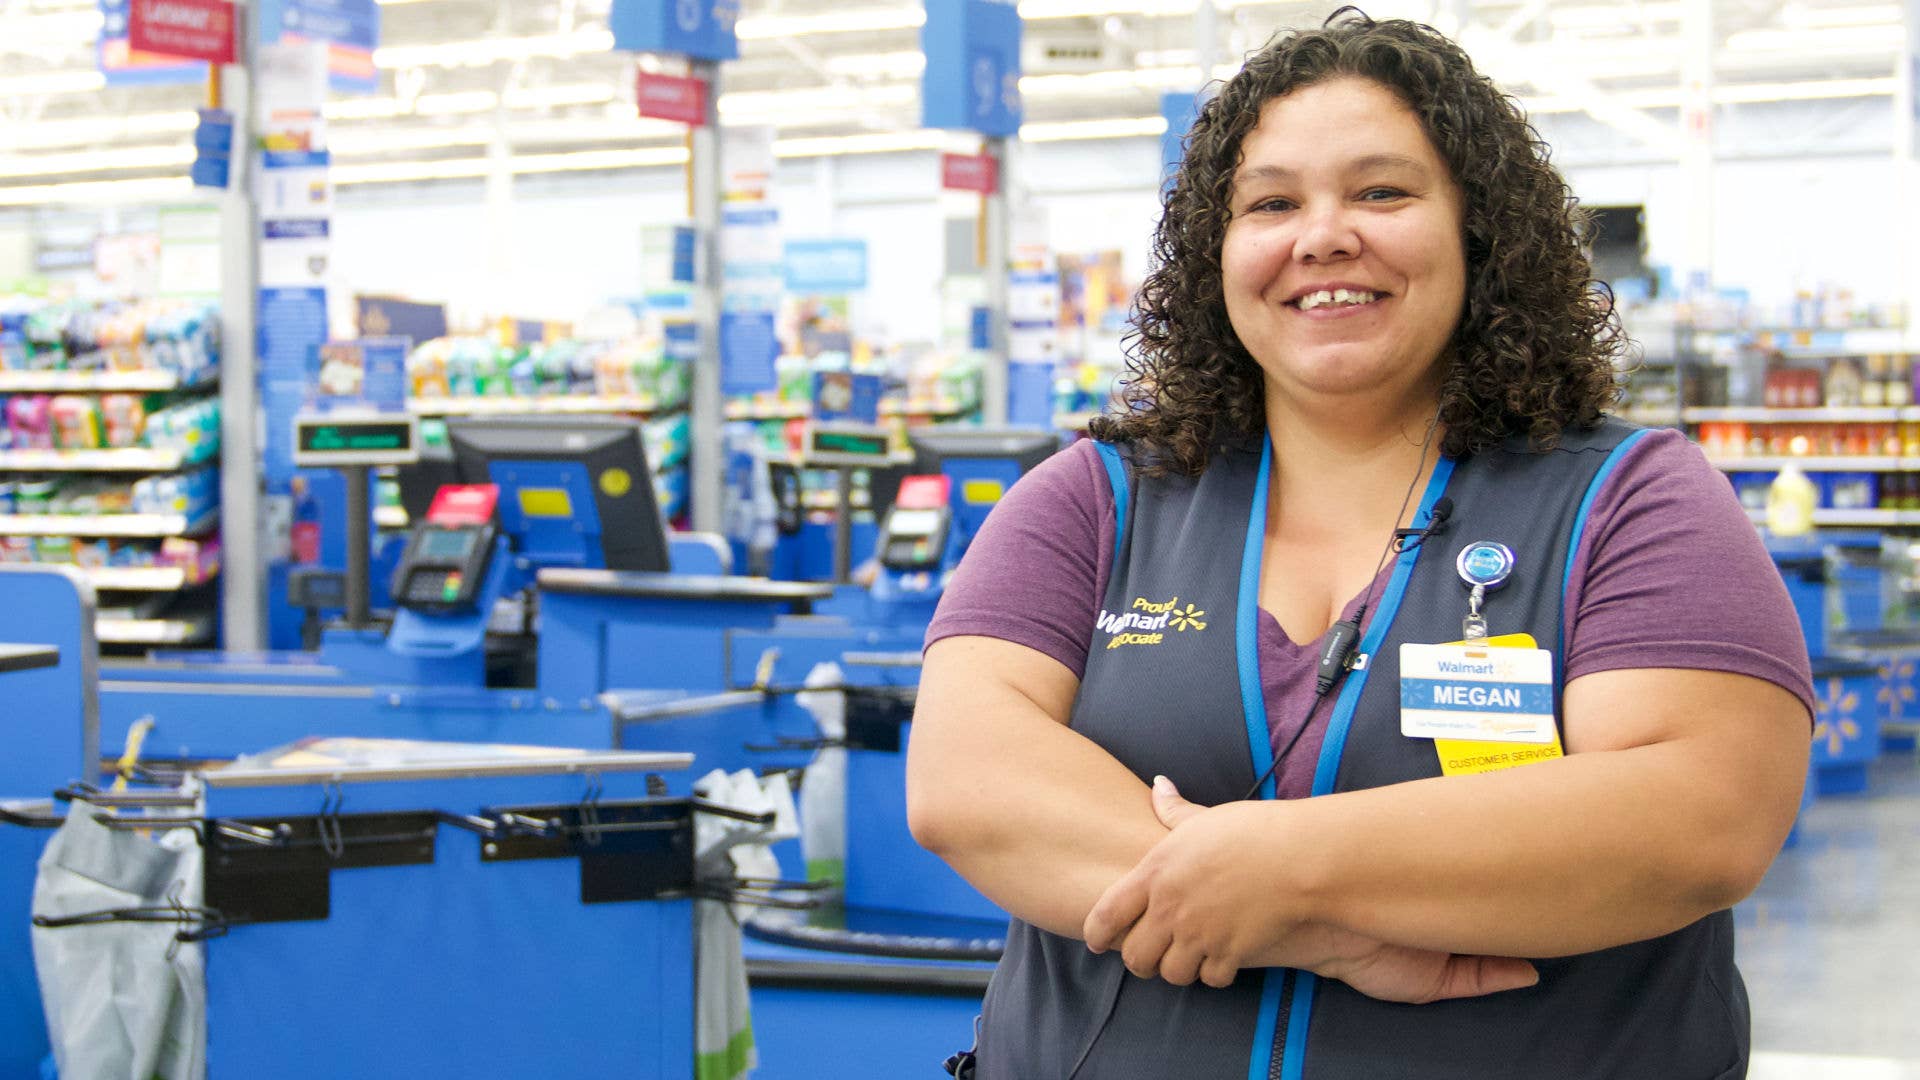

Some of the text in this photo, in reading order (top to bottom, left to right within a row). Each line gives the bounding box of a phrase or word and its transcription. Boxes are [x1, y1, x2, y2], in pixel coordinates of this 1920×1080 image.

[1132, 596, 1178, 613] Proud
[1106, 632, 1164, 650] ociate
[1438, 661, 1494, 674] Walmart
[1433, 685, 1521, 707] MEGAN
[1448, 746, 1558, 769] CUSTOMER SERVICE
